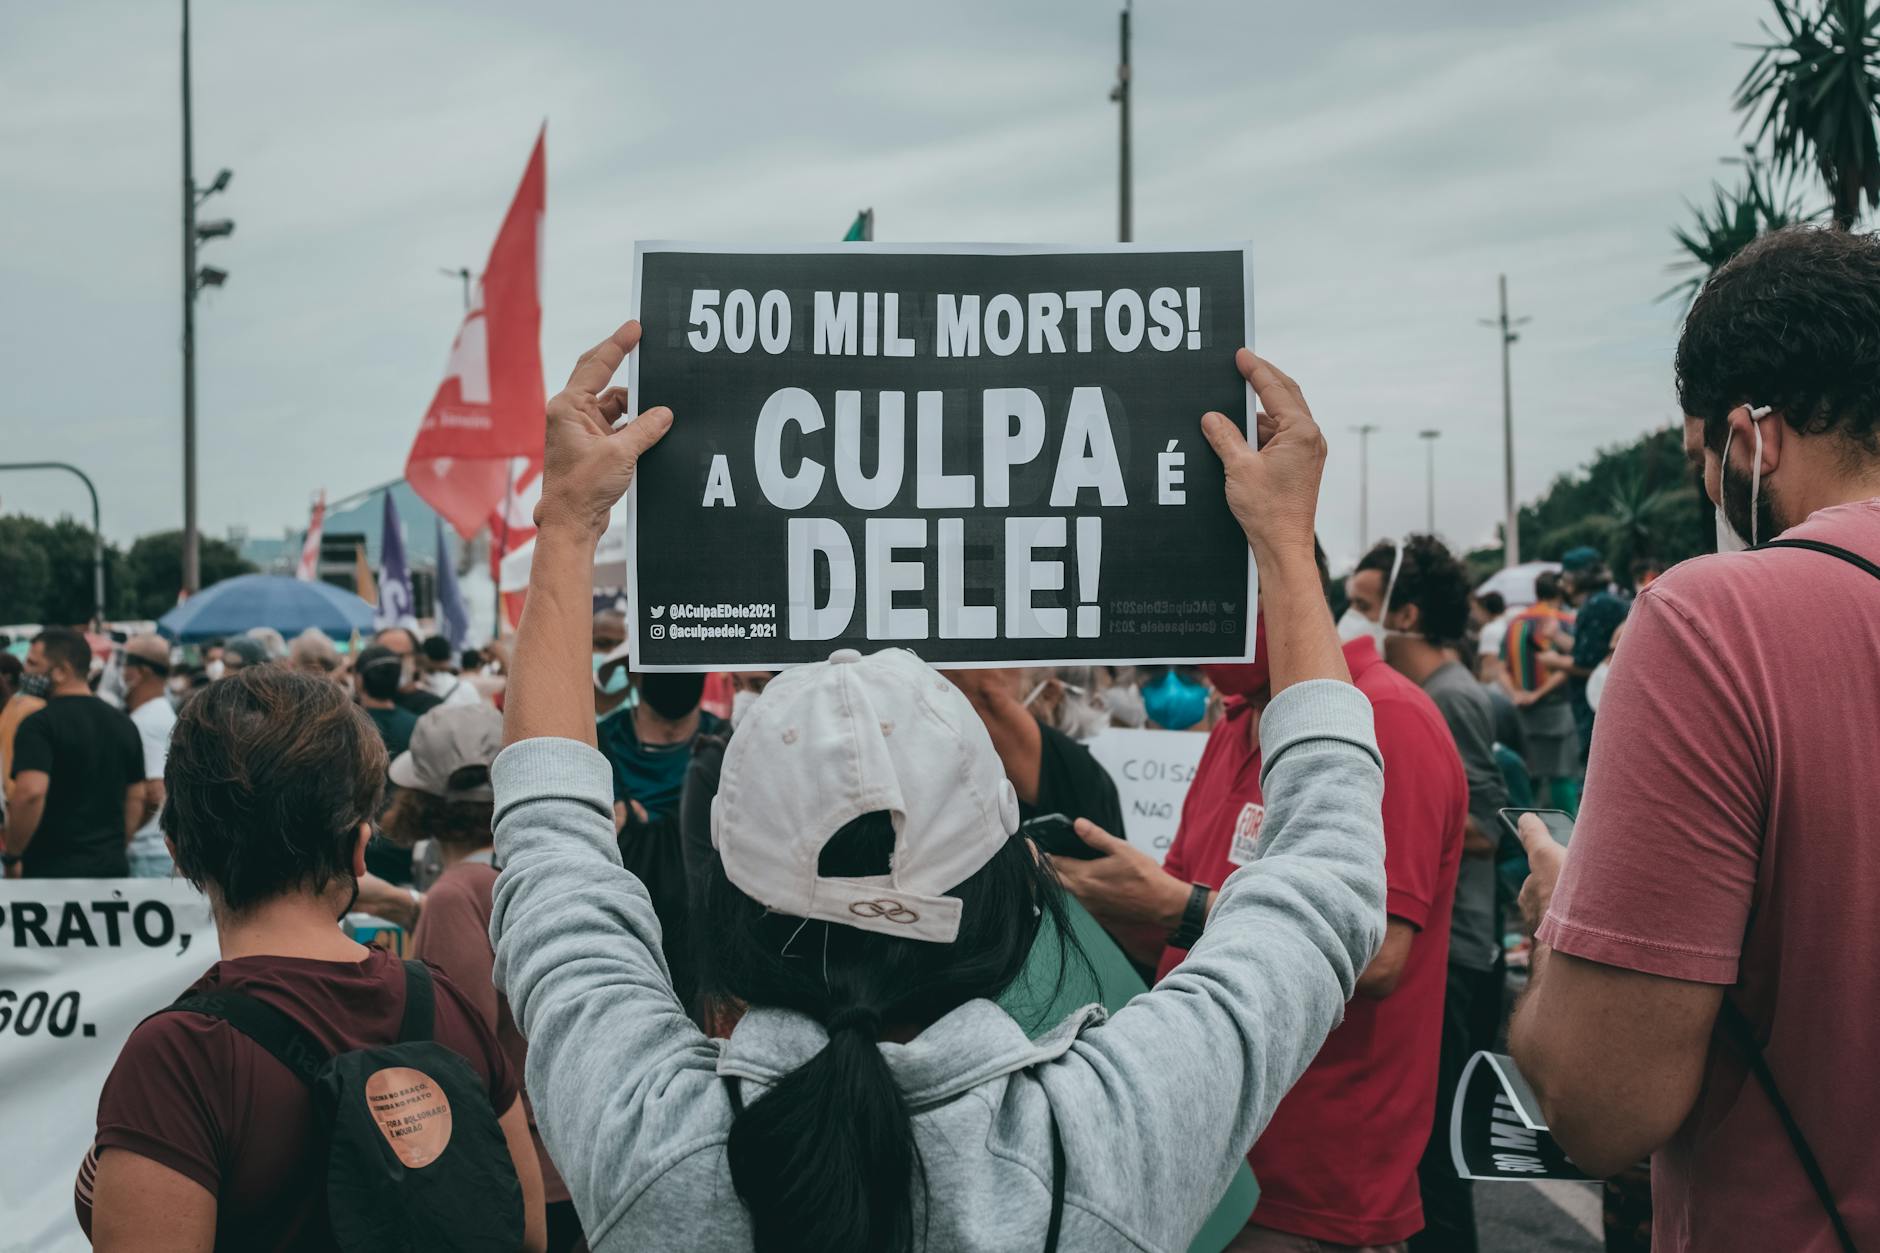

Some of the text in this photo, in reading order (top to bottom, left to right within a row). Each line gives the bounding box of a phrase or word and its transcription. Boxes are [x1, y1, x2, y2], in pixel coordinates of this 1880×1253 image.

[688, 287, 1201, 357] 500 MIL MORTOS!
[703, 387, 1186, 510] A CULPA É
[788, 517, 1102, 641] DELE!
[669, 603, 776, 621] @ACulpaEDele2021
[669, 623, 777, 640] @aculpaedele_2021
[1239, 806, 1264, 840] FOR
[0, 900, 192, 957] RATO,
[1491, 1153, 1548, 1174] 500
